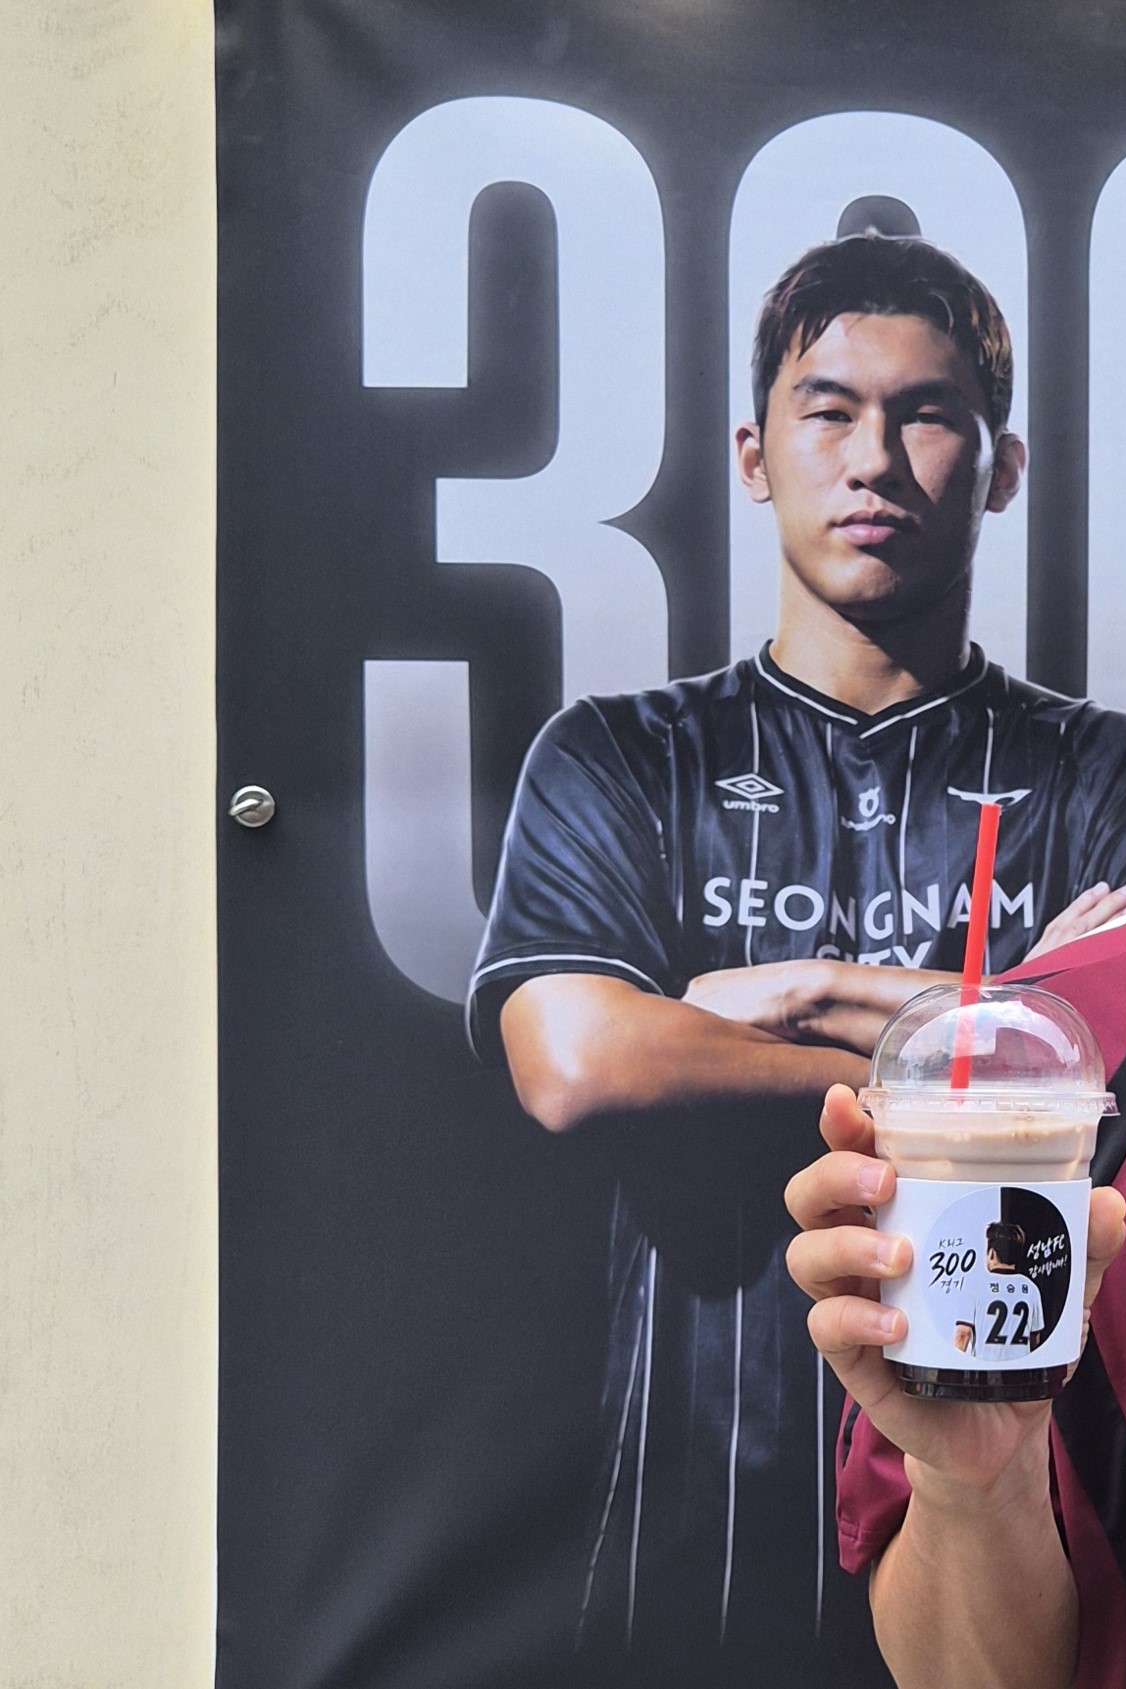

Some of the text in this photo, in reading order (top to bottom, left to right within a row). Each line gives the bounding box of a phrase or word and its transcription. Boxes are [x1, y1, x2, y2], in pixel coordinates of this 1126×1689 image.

[722, 799, 781, 814] umbro
[1026, 1233, 1065, 1260] 성남FC
[928, 1248, 977, 1288] 300
[1028, 1254, 1068, 1279] 감사합니다!
[940, 1276, 965, 1294] 경기
[985, 1300, 1030, 1345] 22
